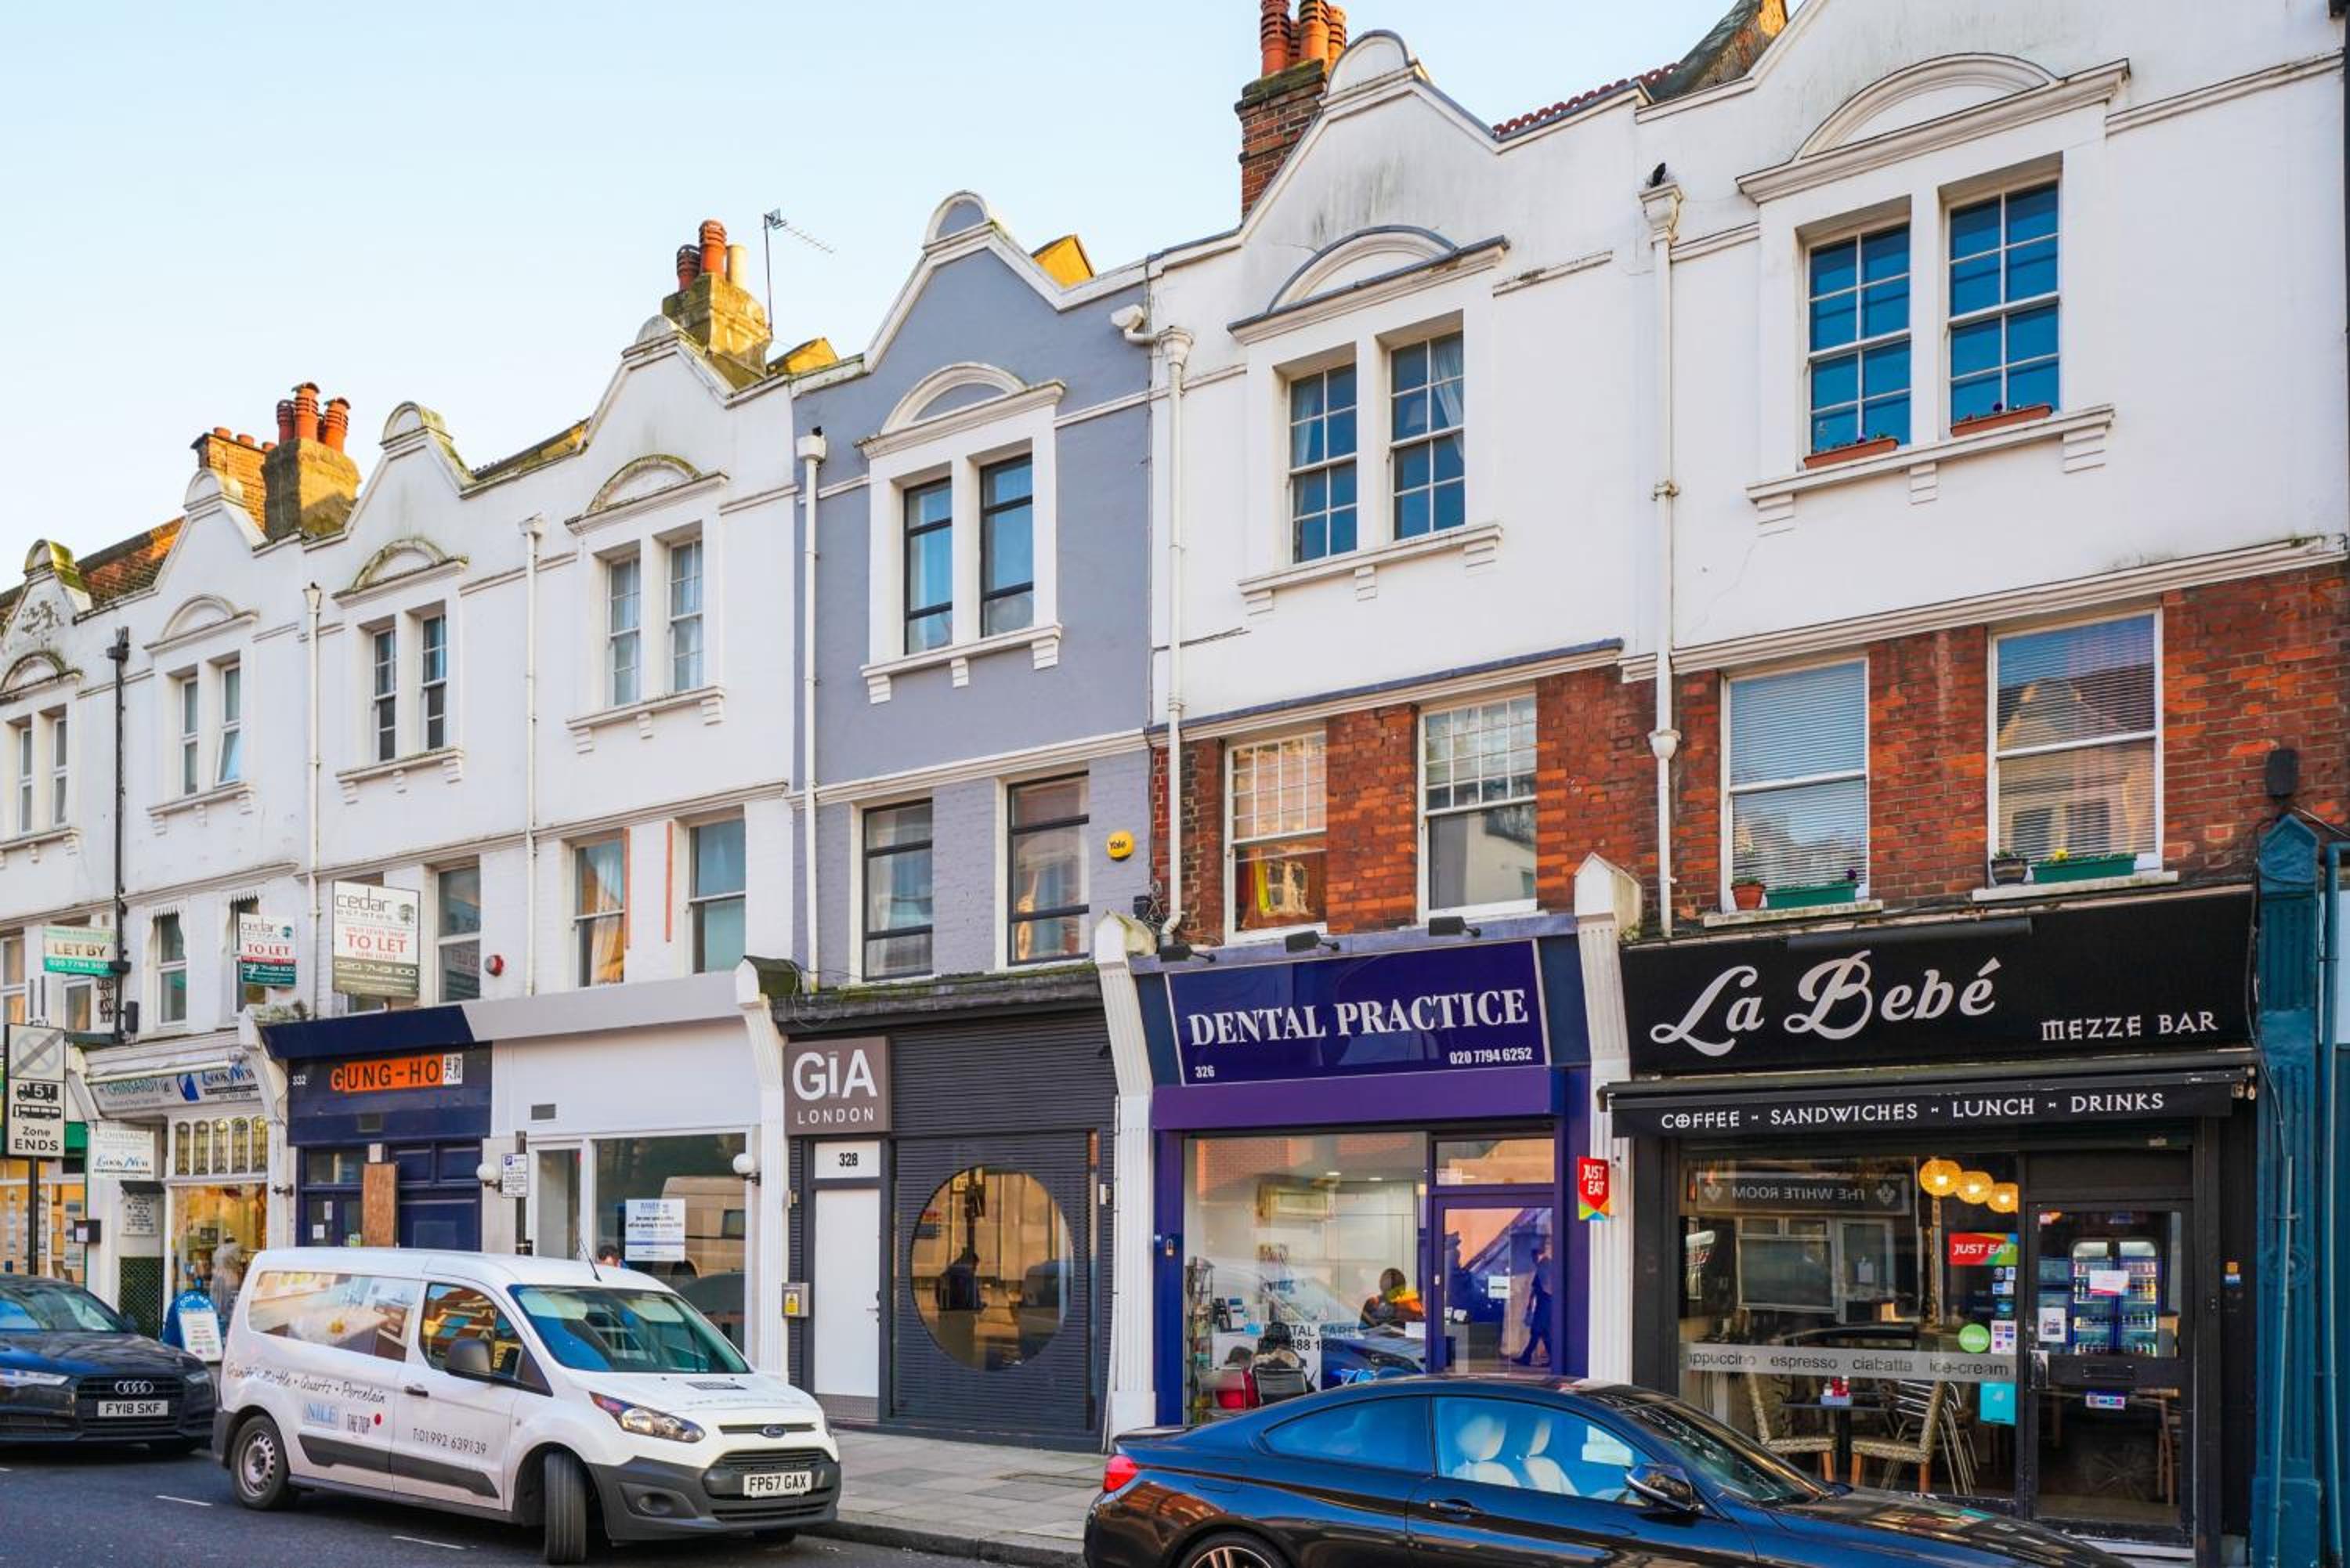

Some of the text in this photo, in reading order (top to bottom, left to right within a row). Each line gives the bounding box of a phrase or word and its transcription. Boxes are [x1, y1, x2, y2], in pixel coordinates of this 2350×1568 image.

[336, 887, 392, 912] cedar
[54, 943, 107, 957] LET BY
[247, 944, 290, 956] TO LET
[345, 934, 407, 953] TO LET
[1650, 949, 2001, 1057] La Bebé
[1188, 989, 1528, 1046] DENTAL PRACTICE
[2041, 1011, 2218, 1041] MEZZE BAR
[1449, 1047, 1532, 1065] 020 7794 6252
[292, 1075, 307, 1086] 332
[333, 1059, 440, 1089] GUNG-HO
[1195, 1065, 1214, 1078] 326
[797, 1107, 874, 1125] LONDON
[1661, 1093, 2164, 1129] COFFEE SANDWICHES LUNCH DRINKS
[22, 1125, 51, 1136] Zone
[15, 1139, 59, 1152] ENDS
[839, 1152, 859, 1167] 328
[1583, 1164, 1605, 1182] JUST
[1587, 1180, 1605, 1196] EAT
[1954, 1242, 2012, 1256] JUST EAT
[1770, 1356, 1838, 1371] espresso
[1853, 1357, 1913, 1372] ciabatta
[1929, 1358, 2009, 1376] ice-cream
[342, 1380, 386, 1405] Porcelain
[106, 1403, 161, 1414] FY18 SKF
[307, 1403, 338, 1424] NILE
[750, 1473, 806, 1492] FP67 GAX
